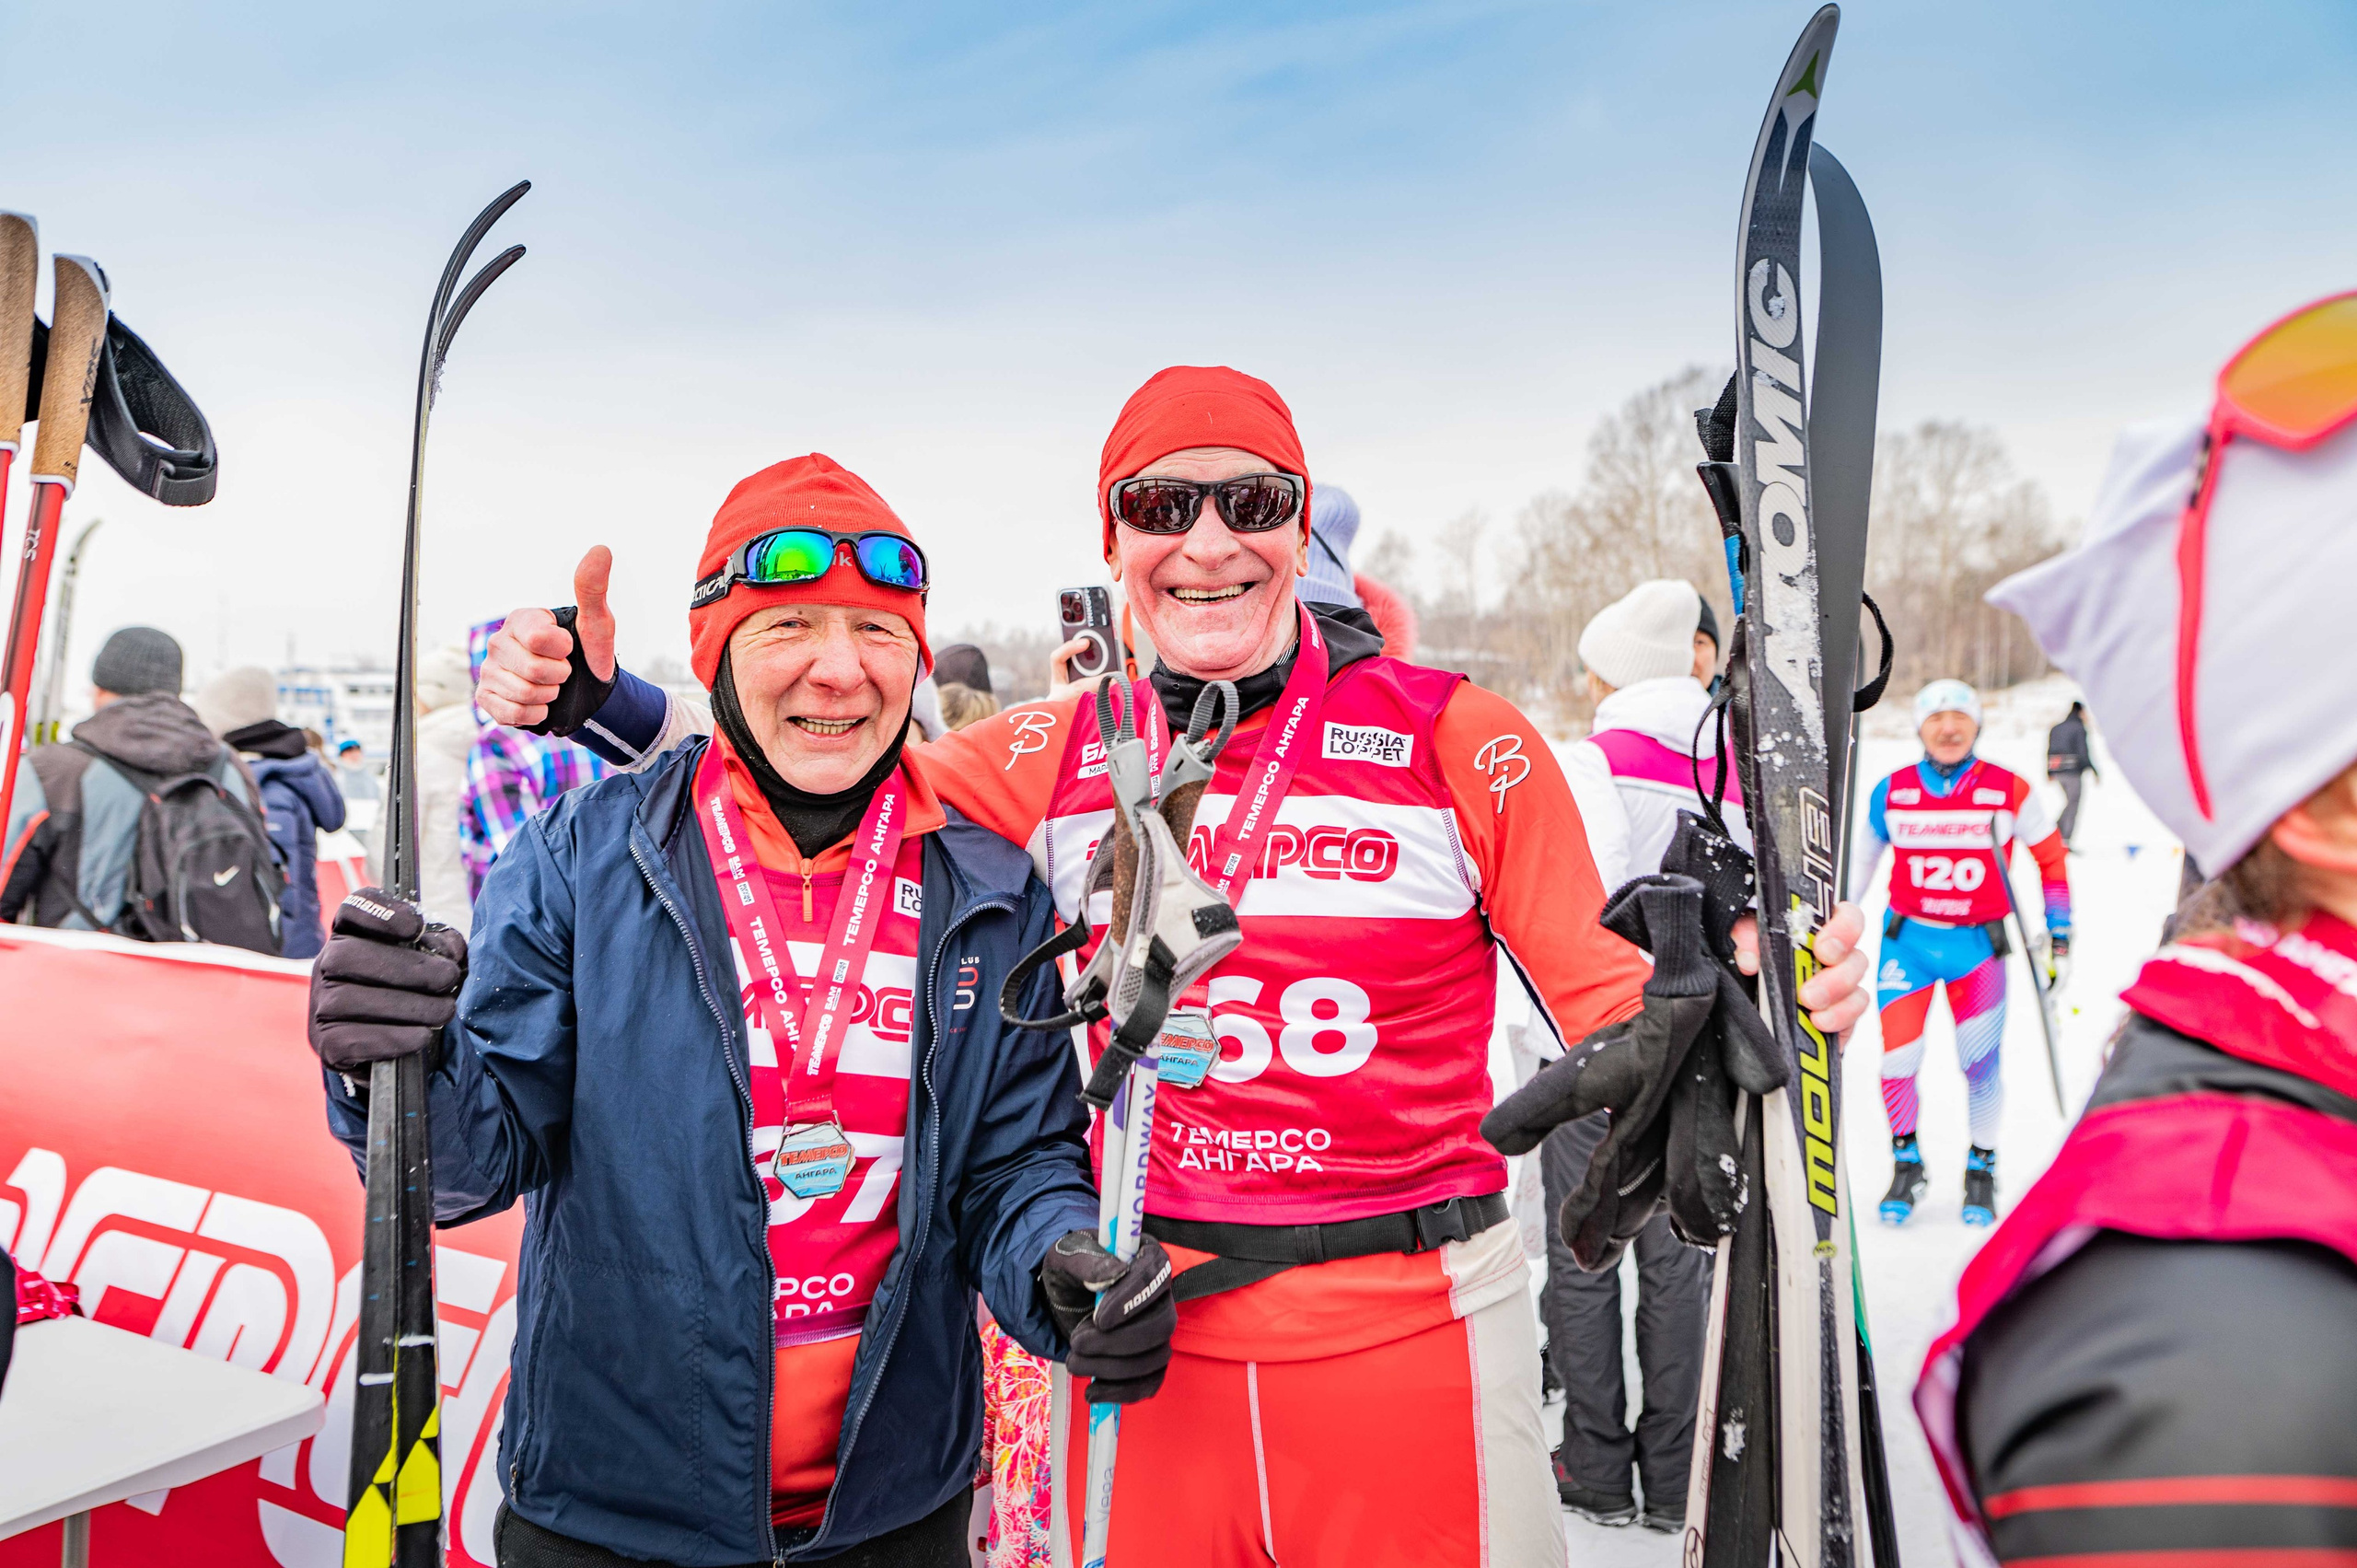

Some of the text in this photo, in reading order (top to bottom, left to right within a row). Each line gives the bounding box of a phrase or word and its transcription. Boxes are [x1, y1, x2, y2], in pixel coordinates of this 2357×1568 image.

[1748, 259, 1821, 741] ATOMIC
[1329, 740, 1404, 761] LOPPET
[1330, 727, 1404, 748] RUSSIA
[1237, 761, 1281, 841] ТЕМЕРСО
[1274, 696, 1310, 759] АНГАРА
[842, 794, 896, 947] ТЕМЕРСО АНГАРА
[1907, 854, 1987, 892] 120
[749, 915, 788, 1005] ТЕМЕРСО
[1208, 975, 1378, 1084] 68
[1170, 1121, 1332, 1153] ТЕМЕРСО
[780, 1143, 849, 1167] ТЕМЕРСО
[1177, 1146, 1325, 1174] АНГАРА
[795, 1166, 838, 1180] АНГАРА
